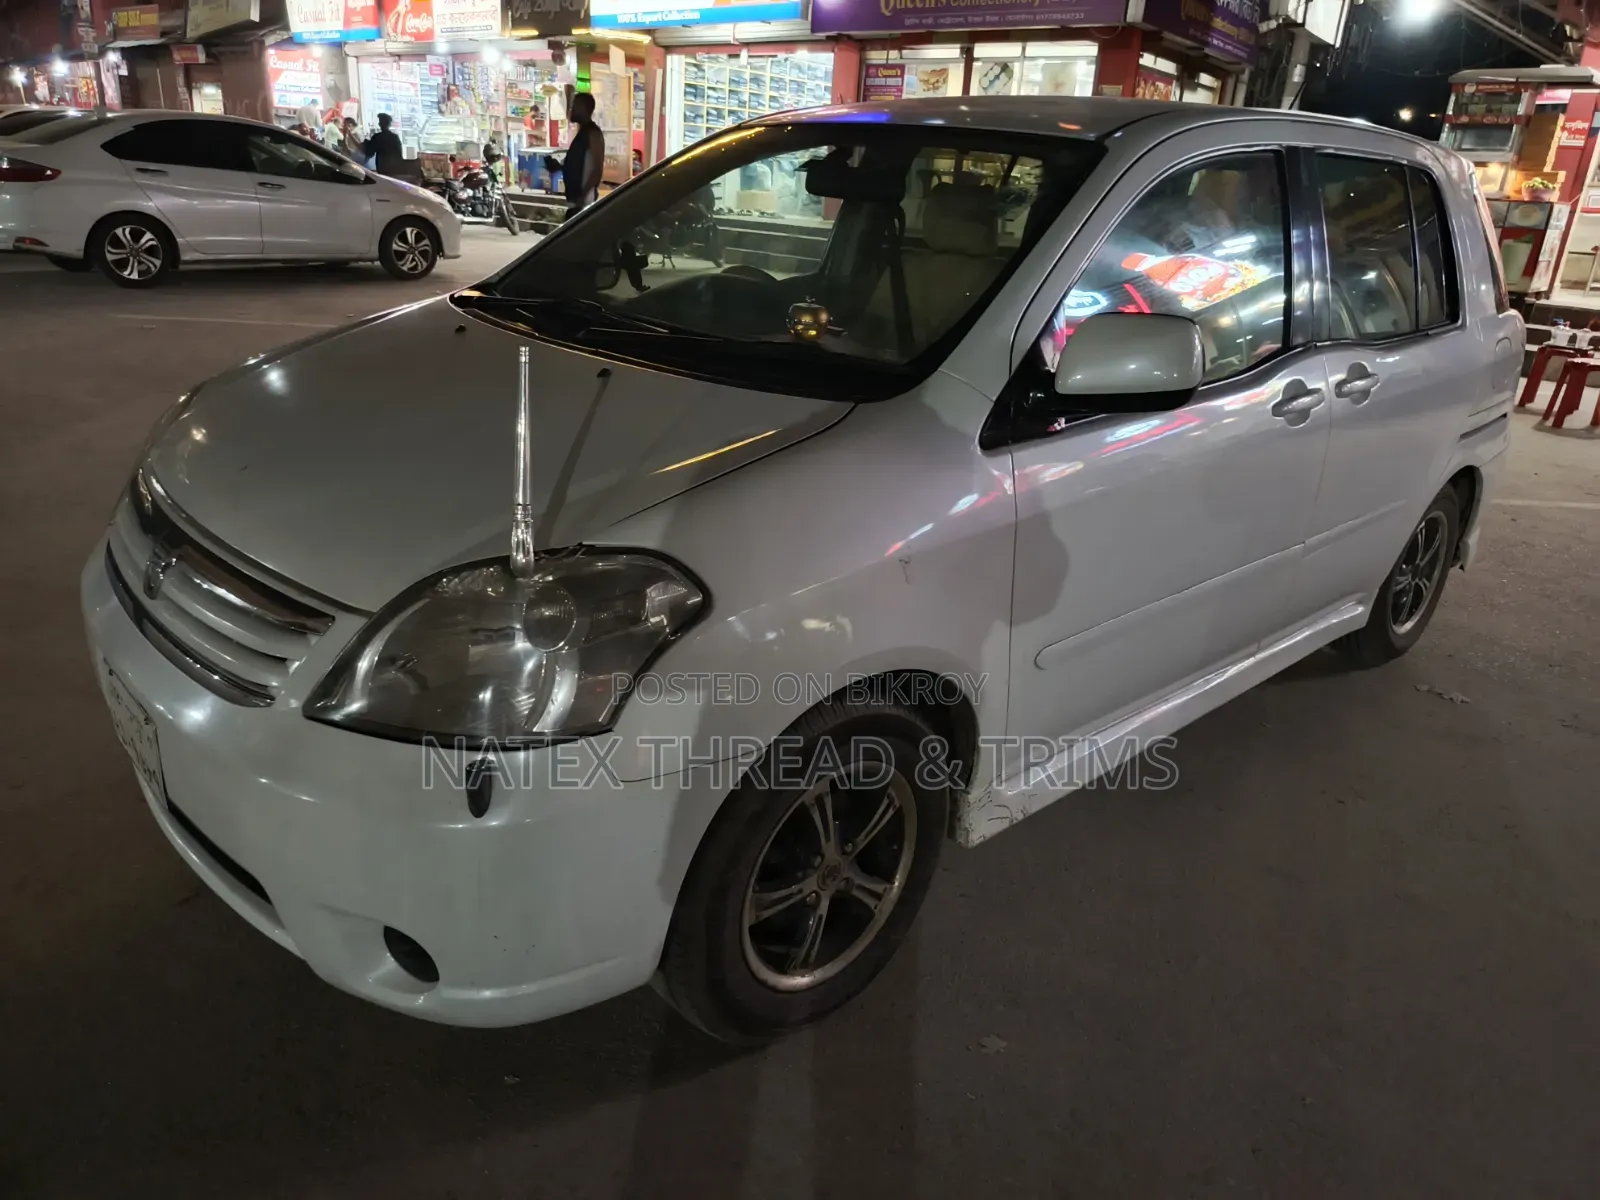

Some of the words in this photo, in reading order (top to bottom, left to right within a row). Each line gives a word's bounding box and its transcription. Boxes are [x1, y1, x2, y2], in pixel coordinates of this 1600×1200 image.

[297, 3, 326, 24] Casual
[637, 12, 662, 25] Export
[269, 55, 304, 72] Casual
[878, 67, 901, 78] Queen's
